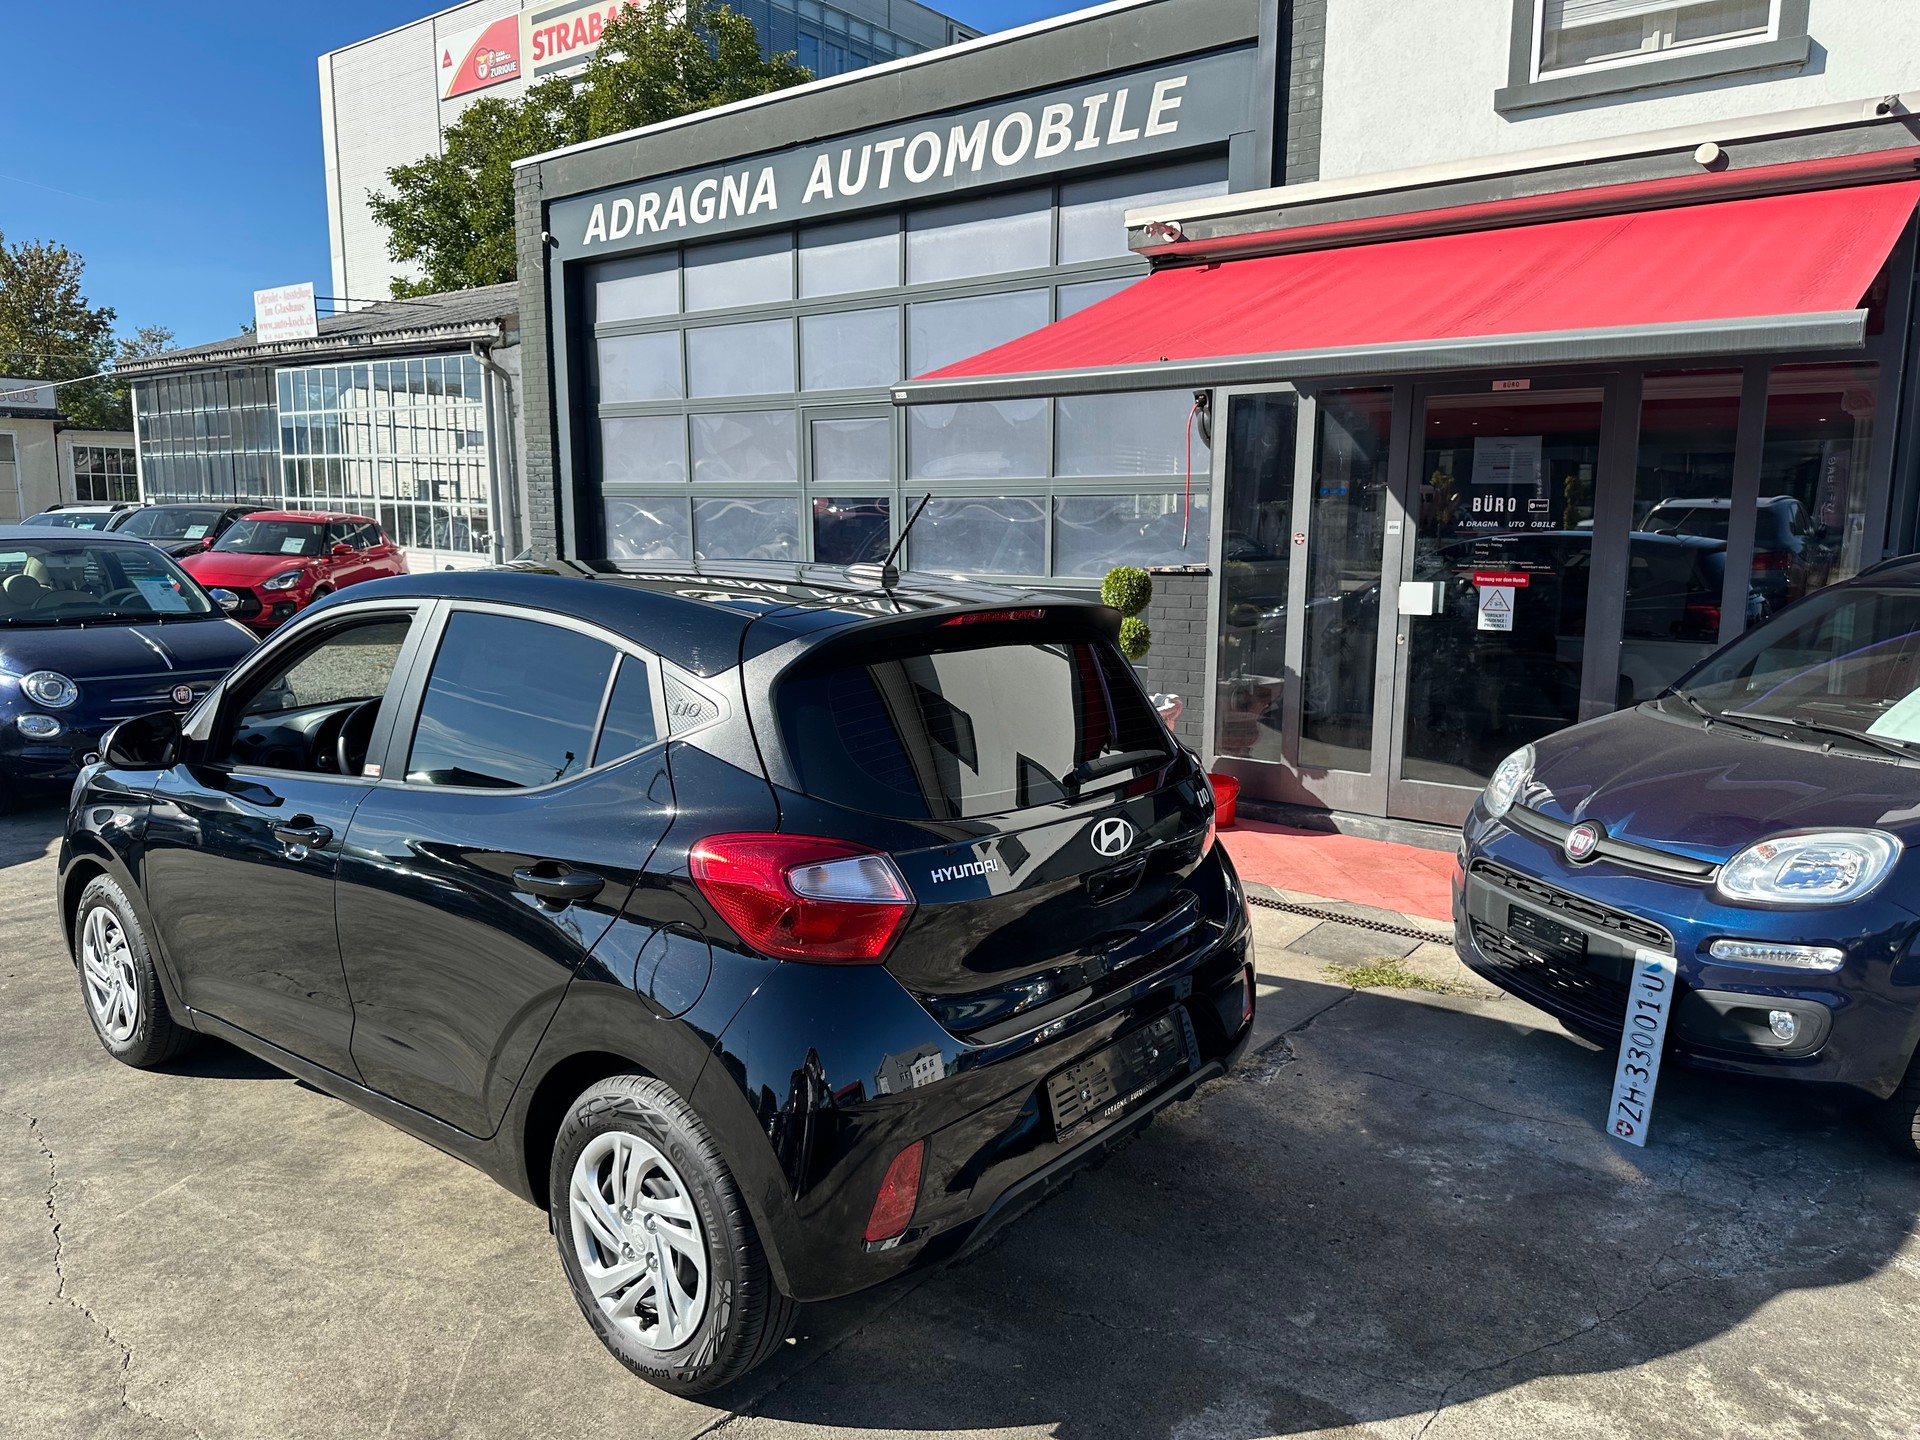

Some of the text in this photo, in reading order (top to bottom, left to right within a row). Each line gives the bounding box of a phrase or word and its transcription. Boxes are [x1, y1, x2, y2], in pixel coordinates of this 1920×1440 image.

[490, 61, 517, 77] ZURIQUE
[582, 75, 1189, 246] ADRAGNA AUTOMOBILE
[1472, 495, 1516, 513] BÜRO
[1570, 833, 1591, 850] FIAT
[931, 859, 999, 884] HYUNDAI
